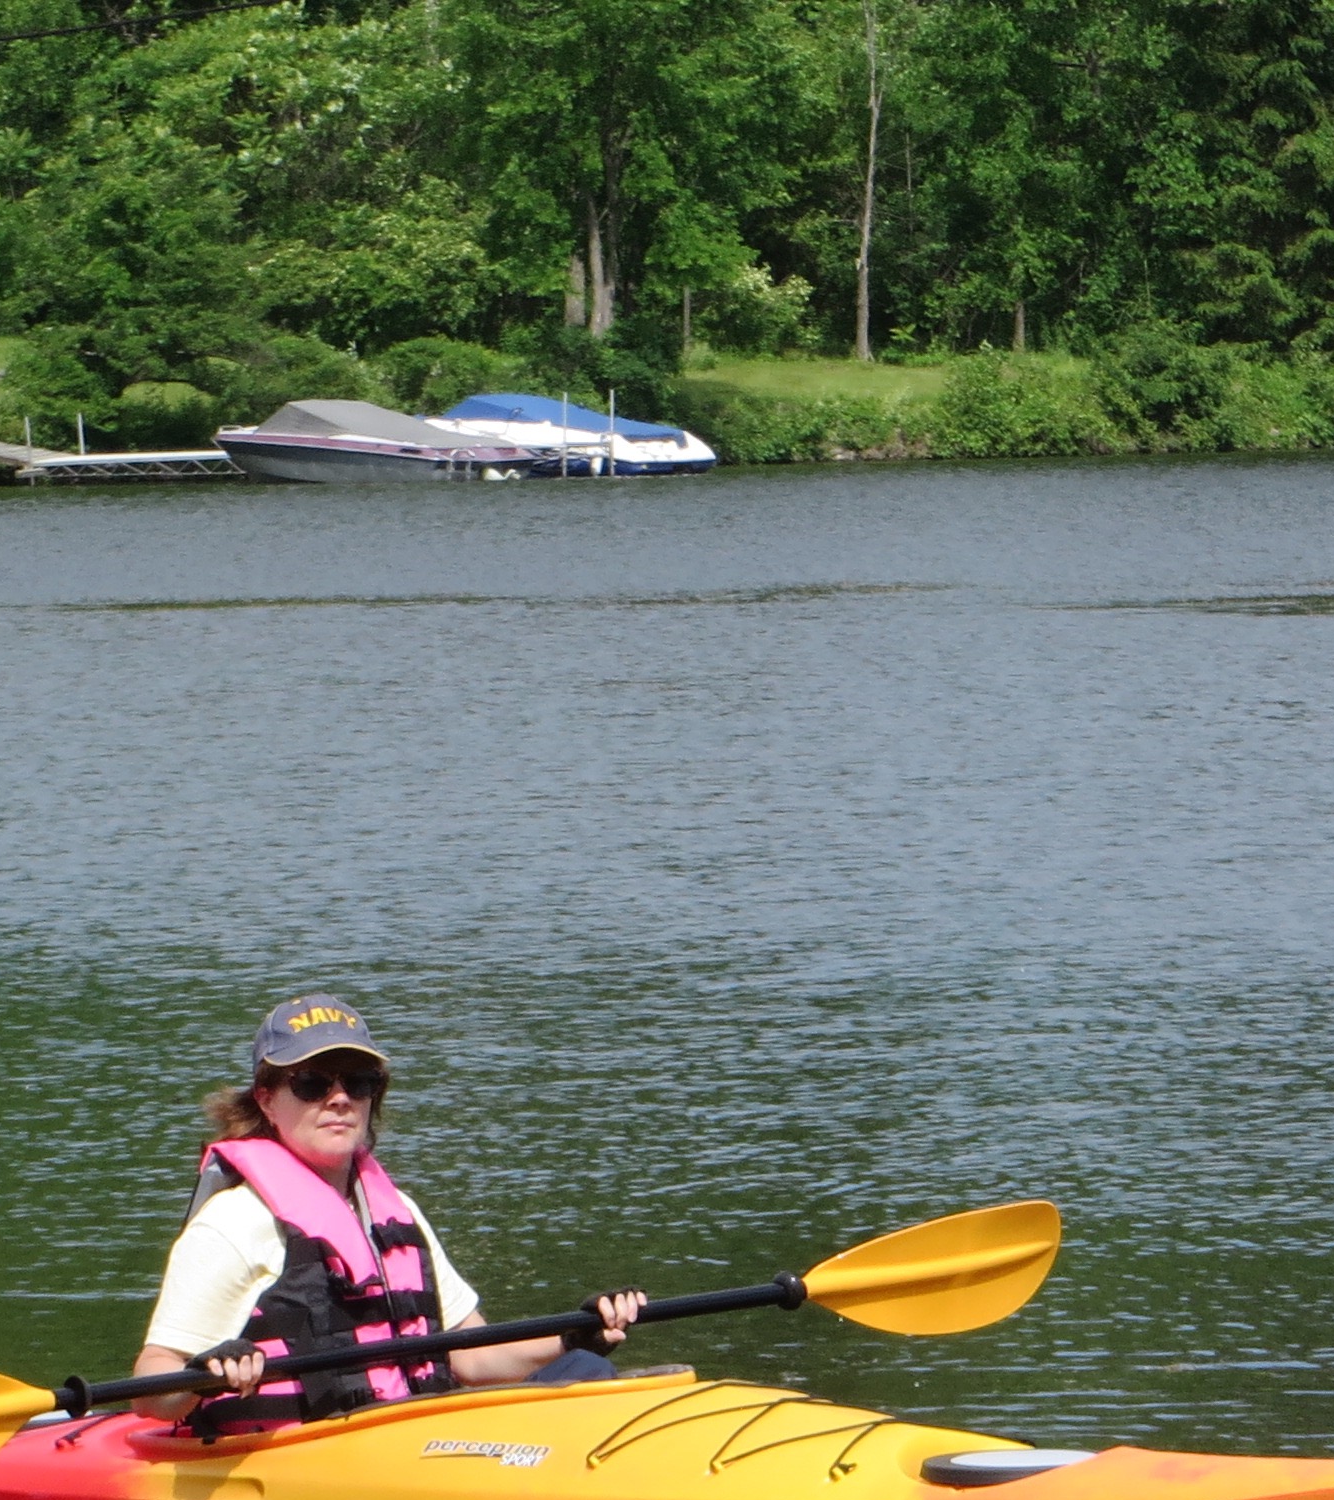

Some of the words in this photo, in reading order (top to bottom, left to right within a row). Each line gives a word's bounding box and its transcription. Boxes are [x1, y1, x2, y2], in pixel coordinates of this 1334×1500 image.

[288, 1007, 357, 1033] NAVY
[422, 1439, 550, 1456] perception
[499, 1453, 544, 1467] SPORT
